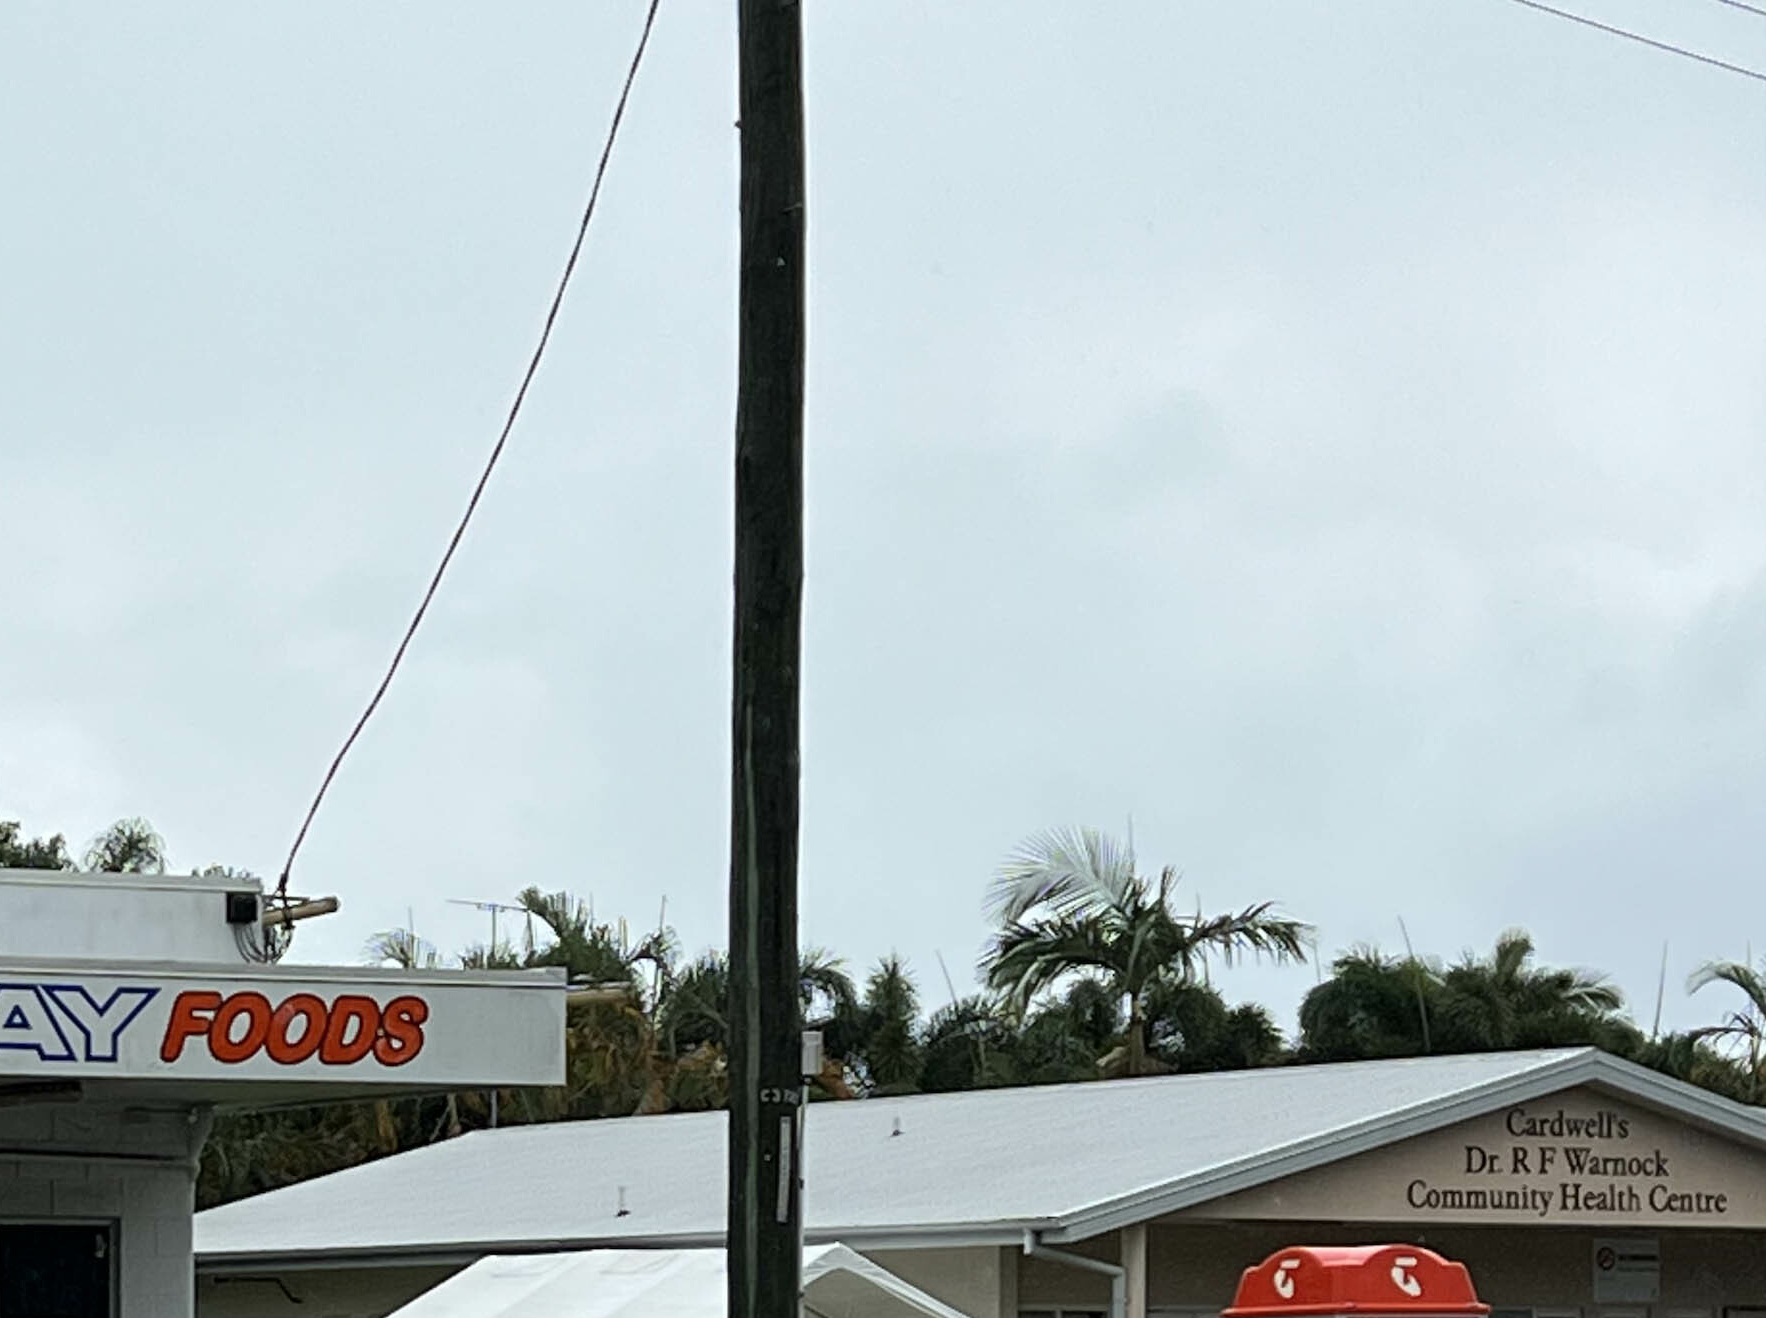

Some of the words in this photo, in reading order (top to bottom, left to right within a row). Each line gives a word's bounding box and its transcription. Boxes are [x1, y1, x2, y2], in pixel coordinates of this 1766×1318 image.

[160, 991, 429, 1066] FOODS
[1506, 1108, 1630, 1139] Cardwell's
[1511, 1147, 1531, 1175] R
[1539, 1147, 1557, 1175] F
[1564, 1147, 1670, 1177] Warnock
[1407, 1179, 1554, 1216] Community
[1559, 1183, 1642, 1213] Health
[1649, 1184, 1727, 1213] Centre
